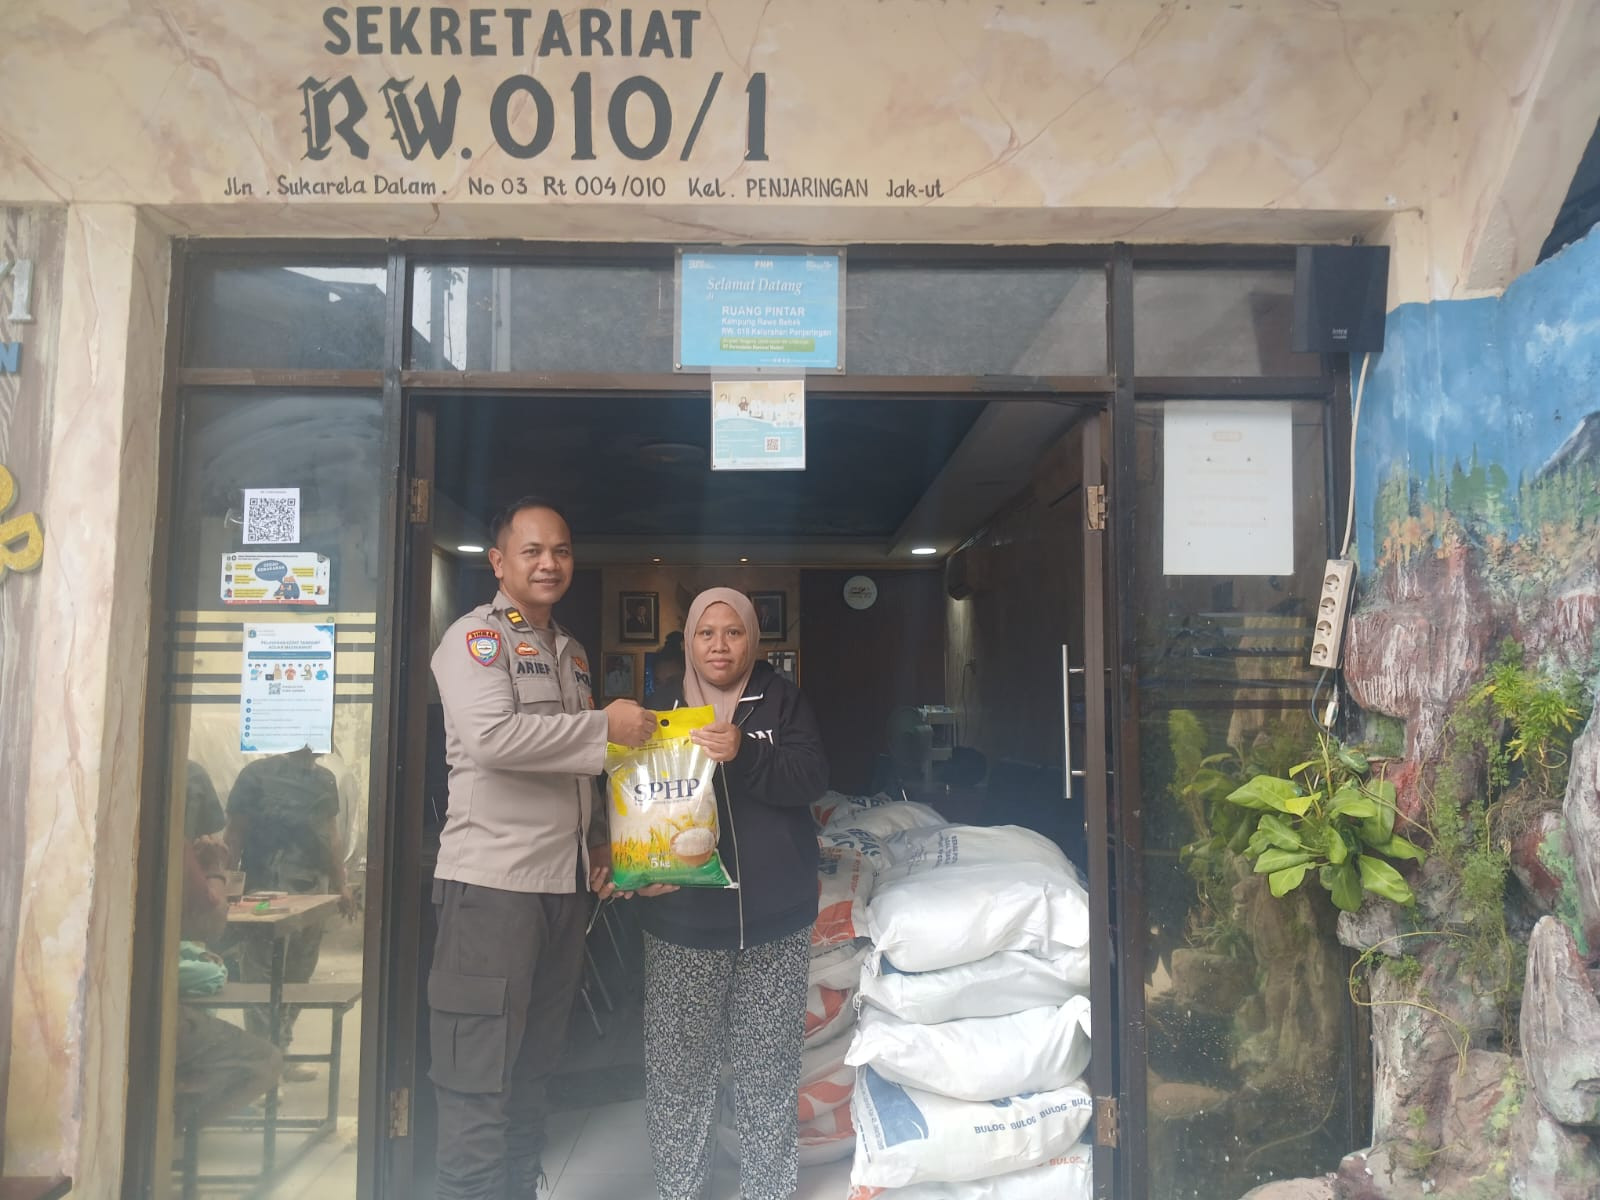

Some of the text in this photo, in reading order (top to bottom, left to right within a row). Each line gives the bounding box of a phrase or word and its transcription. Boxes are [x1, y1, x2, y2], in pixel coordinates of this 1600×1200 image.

[323, 7, 701, 58] SEKRETARIAT
[277, 175, 365, 194] Sukarela
[468, 178, 494, 195] No
[501, 178, 528, 195] 03
[543, 177, 568, 195] Rt
[746, 177, 868, 198] PENJARINGAN
[886, 178, 945, 198] Jak-ut
[706, 277, 803, 294] Selamat Datang
[722, 306, 806, 317] RUANG PINTAR
[516, 661, 551, 675] ARIEF
[634, 778, 700, 801] SPHP
[974, 1123, 1006, 1134] BULOG
[1010, 1115, 1037, 1130] BULOG
[1039, 1103, 1068, 1119] BULOG
